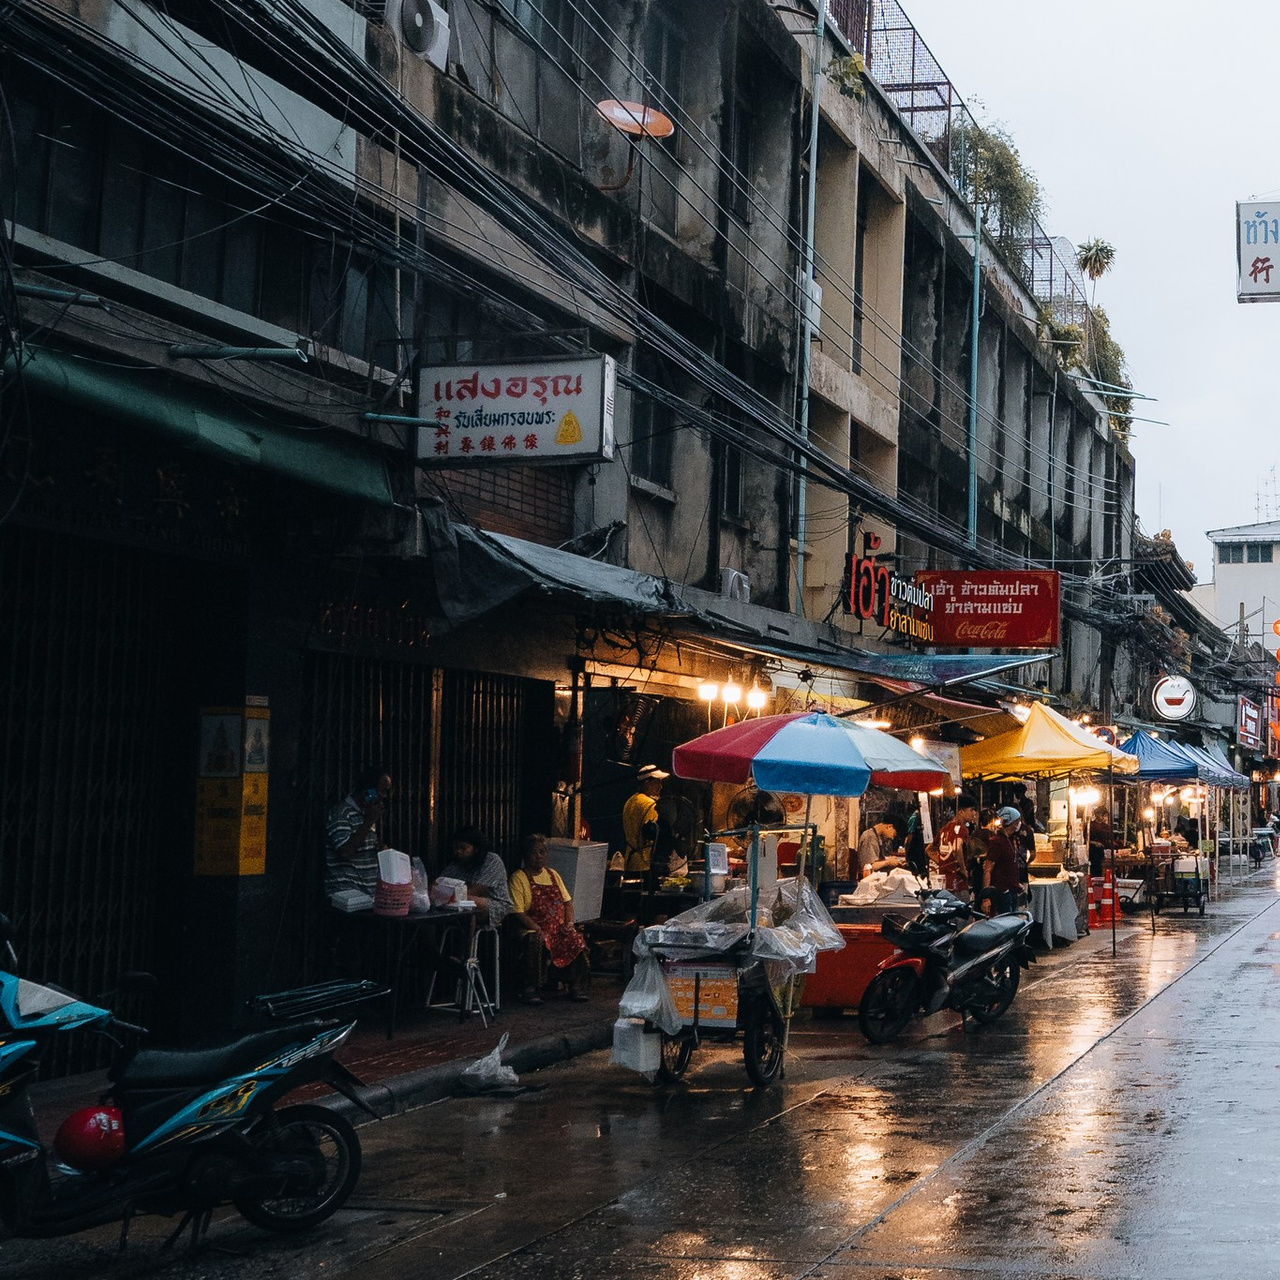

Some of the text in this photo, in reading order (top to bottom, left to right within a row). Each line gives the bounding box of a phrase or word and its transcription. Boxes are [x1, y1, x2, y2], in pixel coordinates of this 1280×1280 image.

[434, 370, 583, 407] แสงอรุณ
[891, 571, 934, 612] ข้าวต้มปลา
[961, 580, 1039, 596] ข้าวต้มปลา
